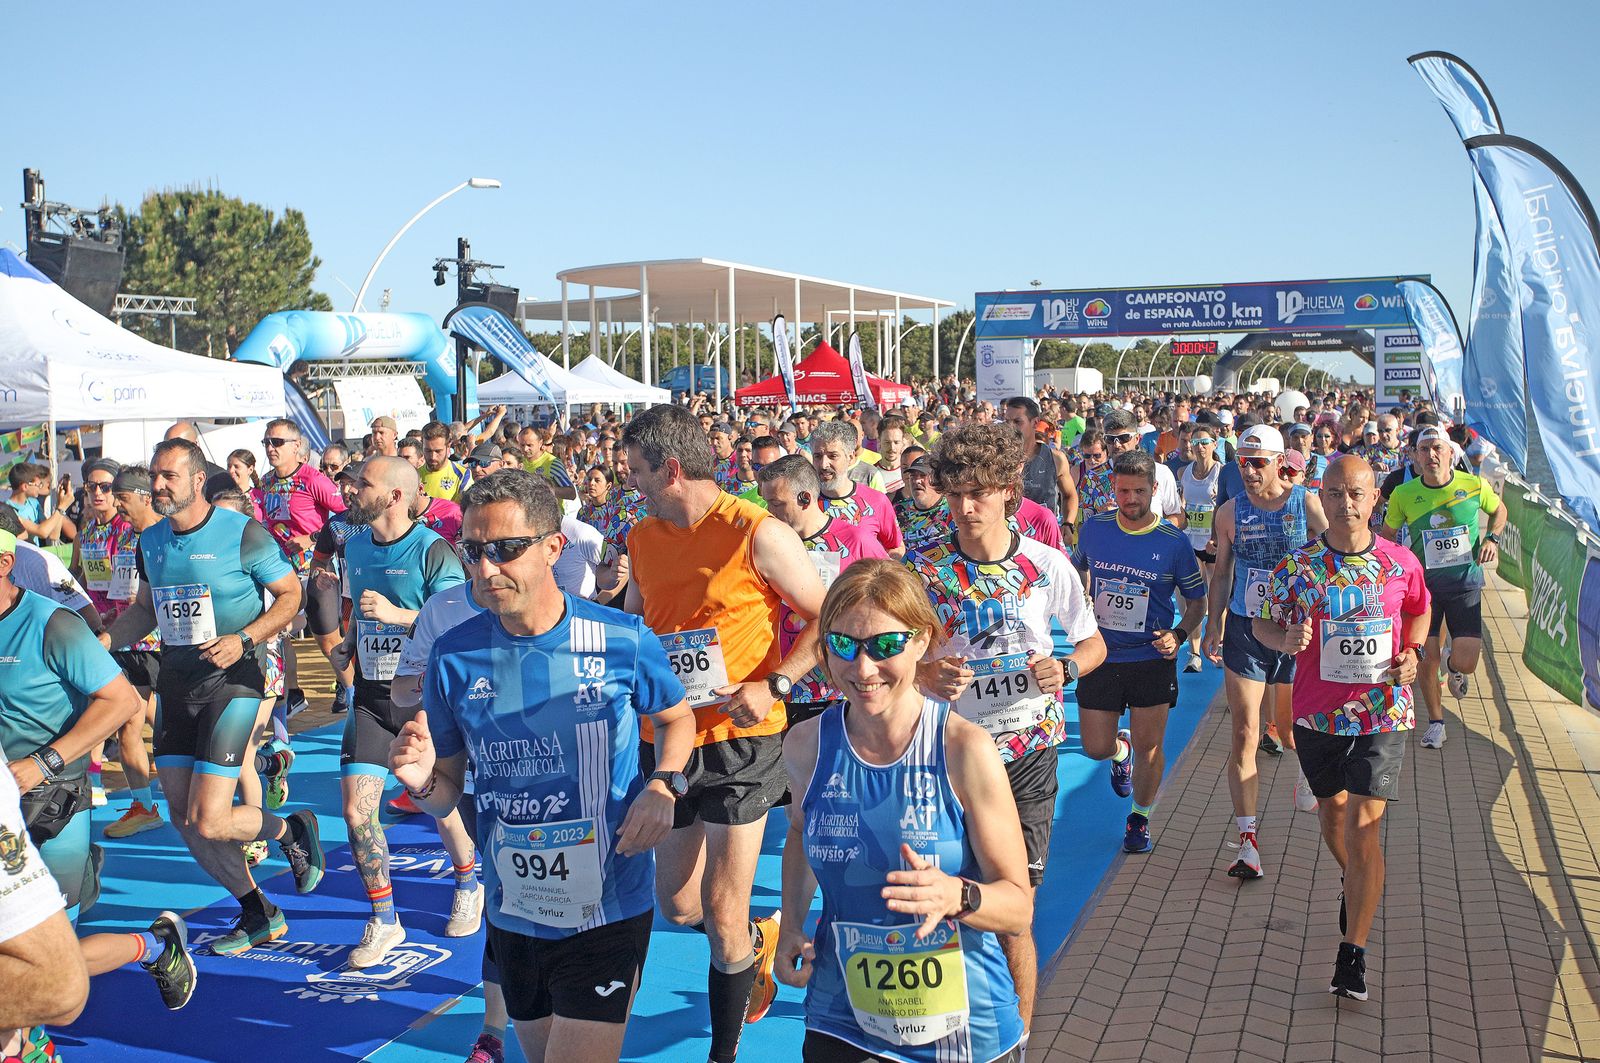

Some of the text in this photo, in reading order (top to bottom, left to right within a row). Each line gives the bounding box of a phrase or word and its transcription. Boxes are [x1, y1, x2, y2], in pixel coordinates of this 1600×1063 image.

[1125, 290, 1226, 305] CAMPEONATO
[1302, 295, 1345, 310] HUELVA
[1125, 302, 1262, 320] de ESPAÑA 10 km
[1191, 320, 1226, 328] Absoluto
[1235, 319, 1262, 327] Master
[1435, 537, 1460, 551] 969
[88, 561, 106, 573] 845
[117, 567, 140, 580] 1717
[1094, 560, 1158, 581] ZALAFITNESS
[187, 588, 204, 597] 2023
[1106, 593, 1135, 611] 795
[162, 601, 202, 620] 1592
[387, 624, 406, 633] 2023
[1370, 624, 1387, 633] 2023
[363, 637, 402, 654] 1442
[689, 634, 711, 645] 2023
[1339, 638, 1377, 656] 620
[970, 673, 1029, 700] 1419
[998, 717, 1020, 726] Syrluz
[479, 730, 565, 763] AGRITRASA
[508, 813, 540, 821] THERAPY
[818, 811, 860, 828] AGRITRASA
[552, 827, 585, 844] 2023
[808, 844, 844, 862] iPhysio
[511, 852, 570, 881] 994
[538, 907, 564, 918] Syrluz
[859, 934, 883, 946] HUELVA
[856, 957, 943, 991] 1260
[878, 997, 925, 1006] ANA ISABEL
[878, 1008, 927, 1017] MANSO DIEZ
[893, 1023, 927, 1035] Syrluz
